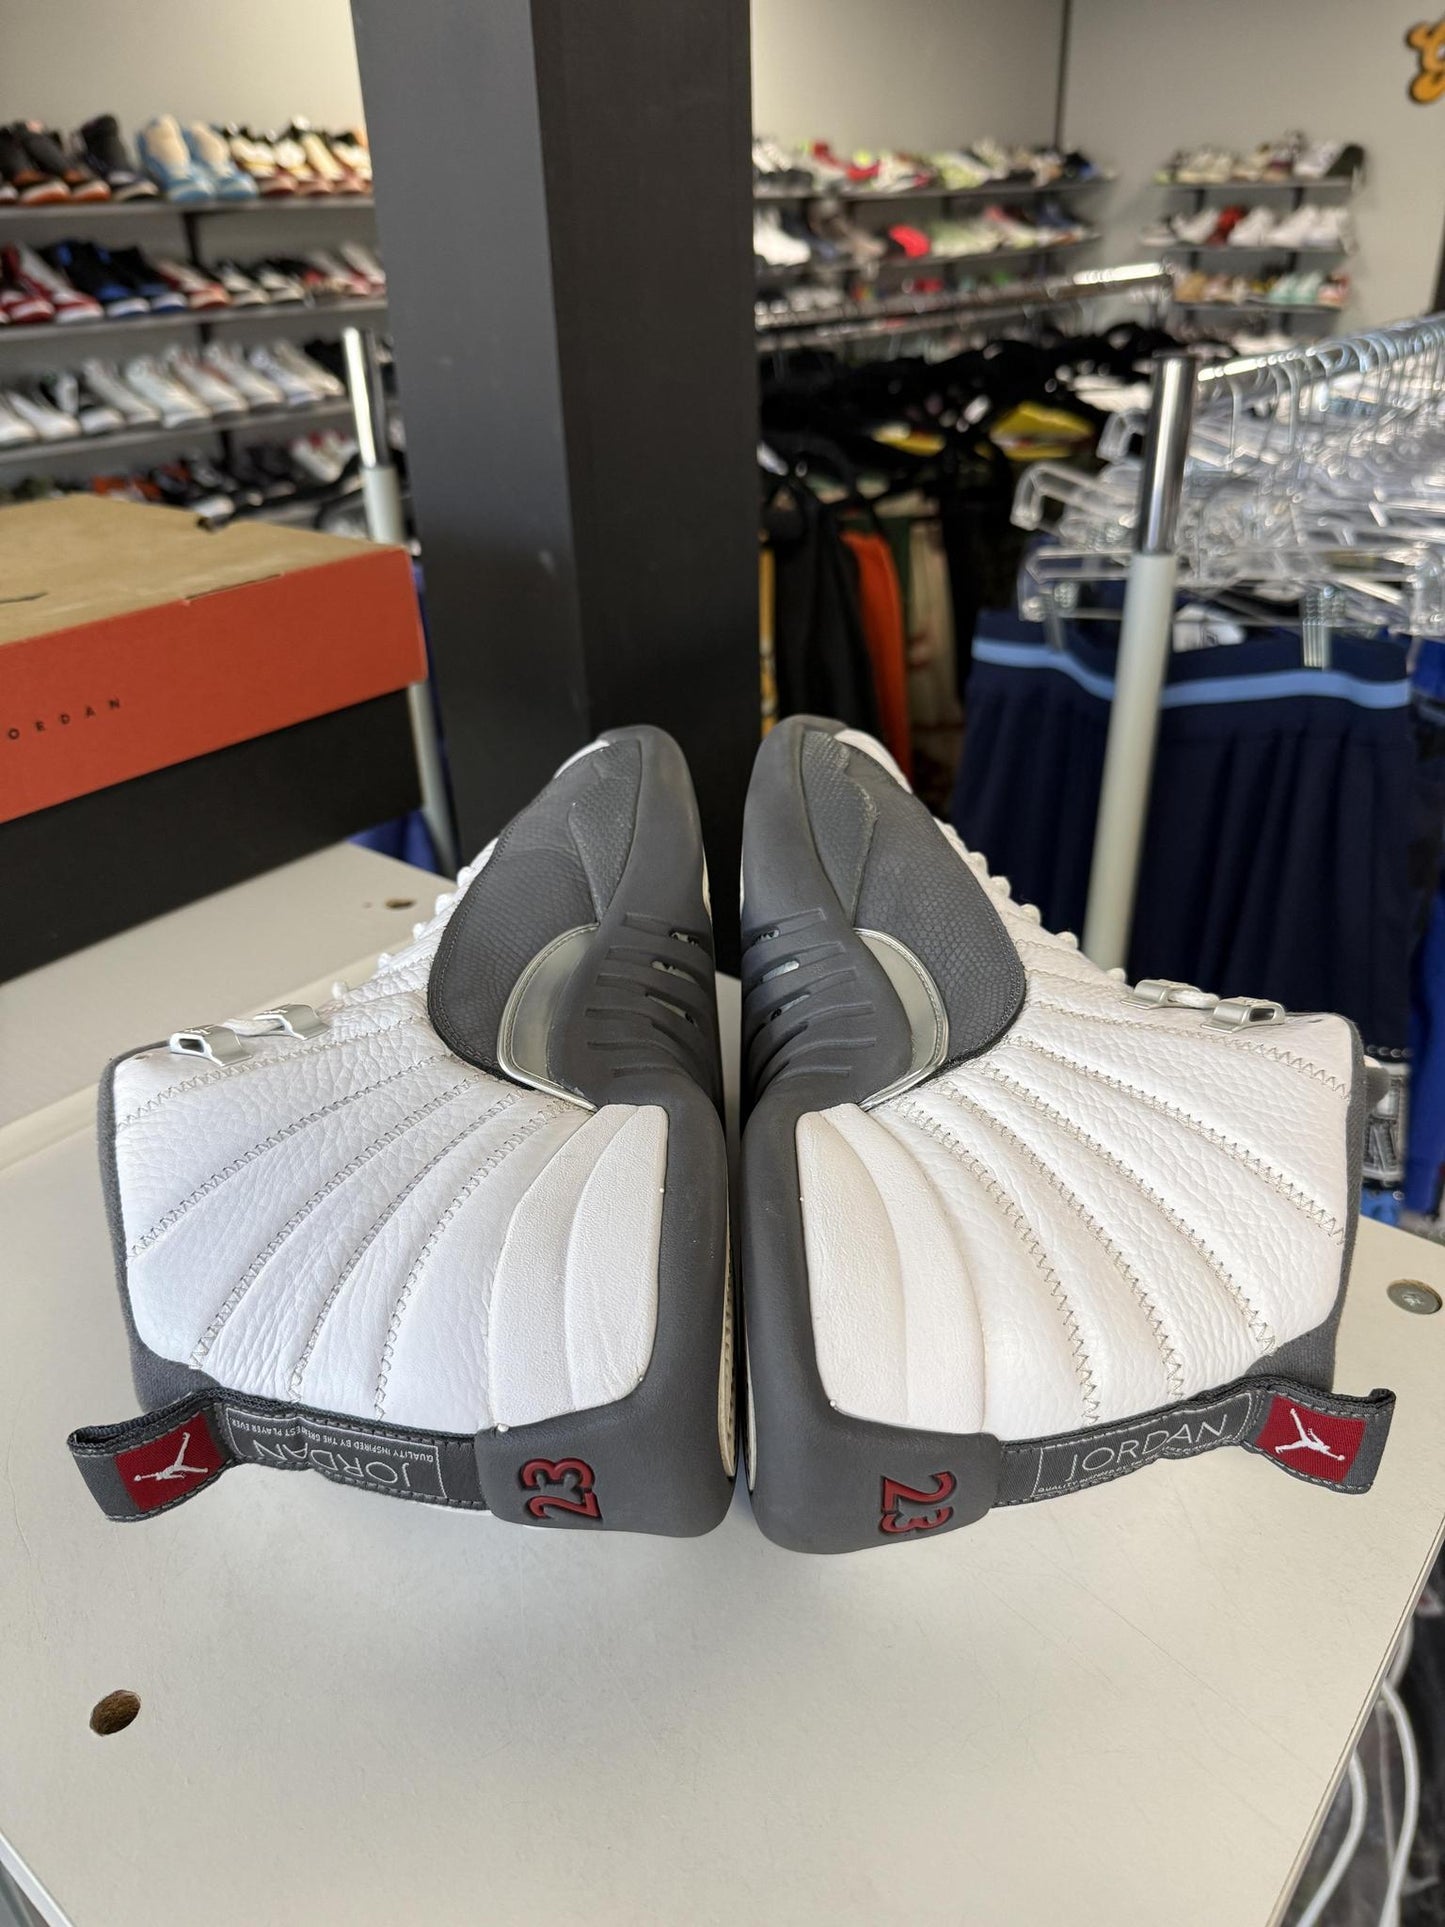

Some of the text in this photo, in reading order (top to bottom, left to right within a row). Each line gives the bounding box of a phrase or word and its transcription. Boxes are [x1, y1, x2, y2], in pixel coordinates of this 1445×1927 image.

[7, 698, 121, 740] ORDAN
[251, 1424, 283, 1437] PLAYER
[322, 1434, 338, 1446] THE
[340, 1438, 352, 1448] BY
[353, 1440, 391, 1455] INSPIRED
[393, 1448, 434, 1463] QUALITY
[1064, 1413, 1228, 1482] JORDAN
[252, 1439, 411, 1488] JORDAN
[519, 1457, 604, 1521] 23
[879, 1470, 957, 1534] 23
